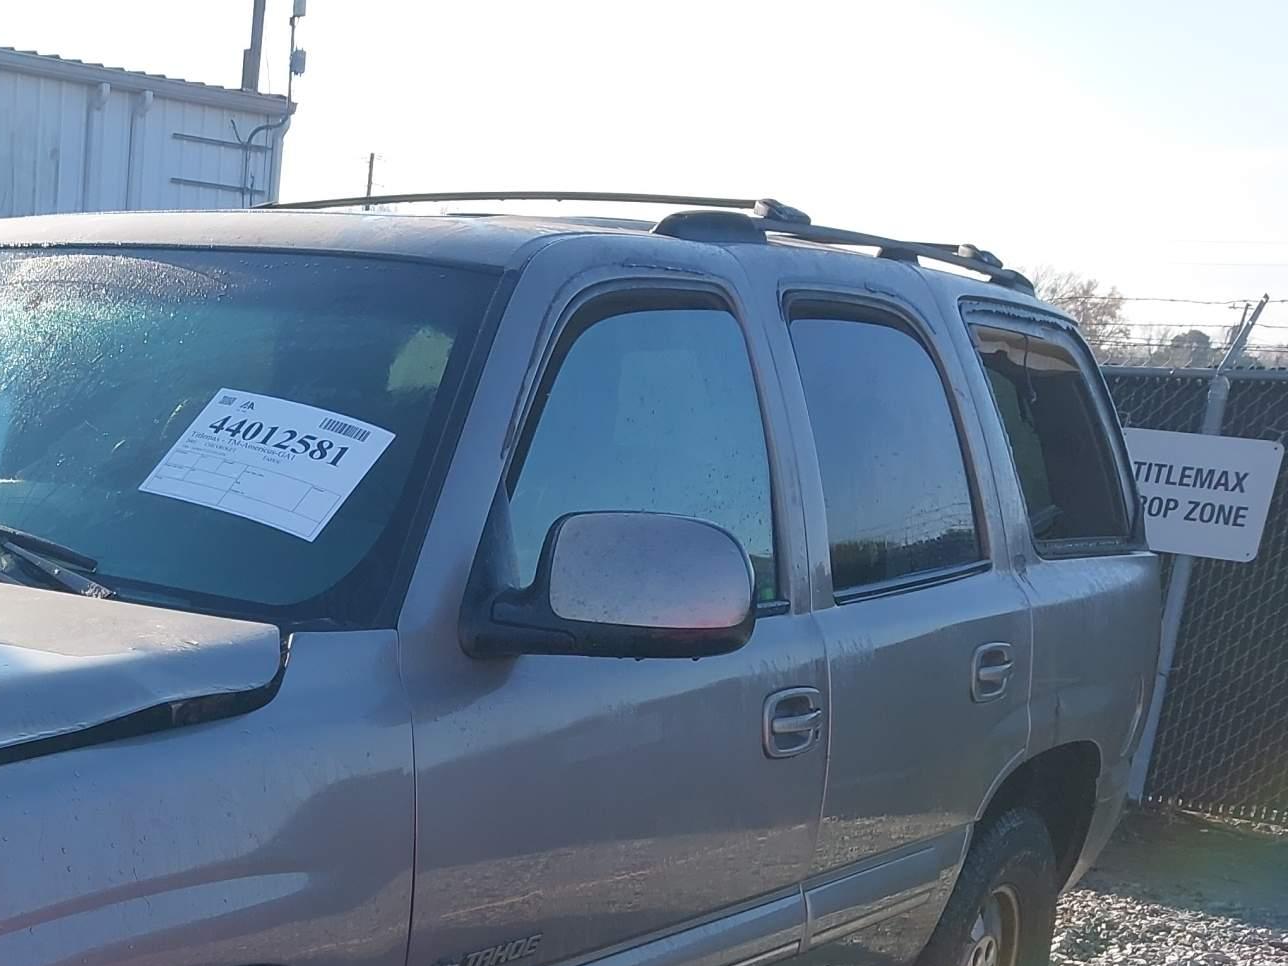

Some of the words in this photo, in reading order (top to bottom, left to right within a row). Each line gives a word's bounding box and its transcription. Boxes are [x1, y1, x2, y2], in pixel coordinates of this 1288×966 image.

[208, 415, 350, 467] 44012581
[1134, 461, 1250, 494] TITLEMAX
[1183, 501, 1249, 528] ZONE
